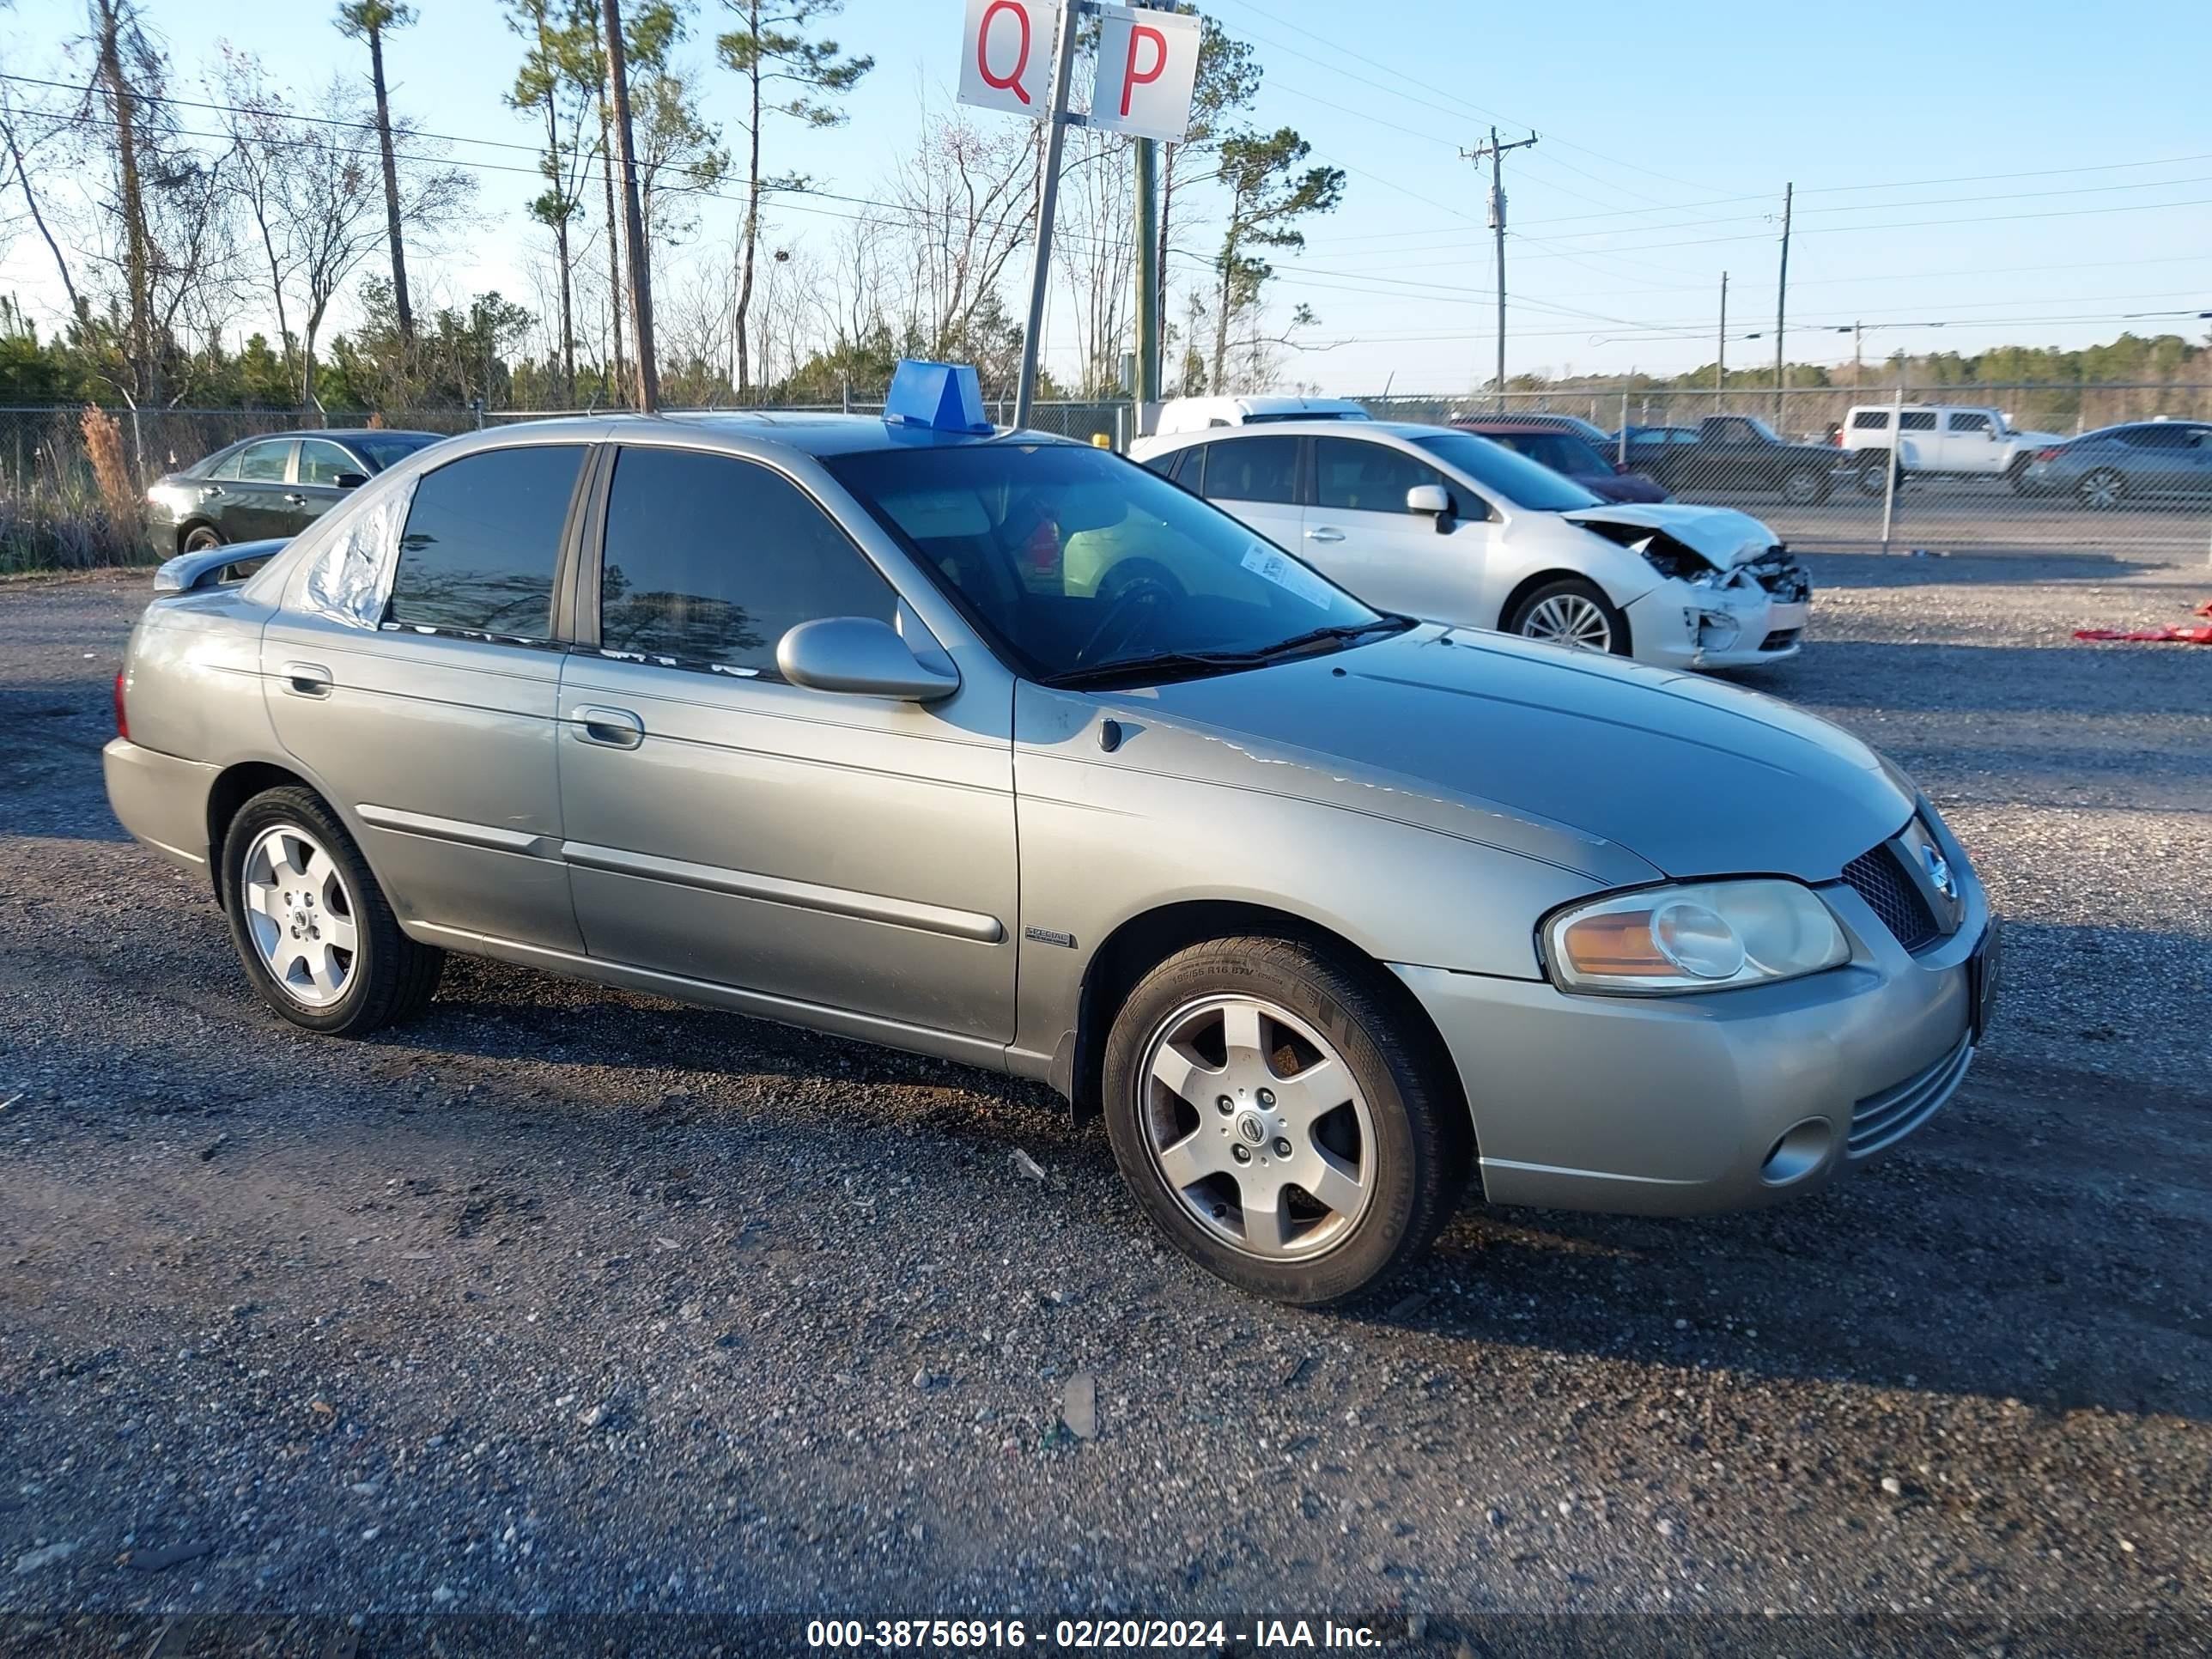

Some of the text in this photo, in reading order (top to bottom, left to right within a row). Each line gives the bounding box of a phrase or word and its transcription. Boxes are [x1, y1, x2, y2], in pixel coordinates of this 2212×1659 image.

[978, 0, 1030, 105] Q
[1121, 25, 1167, 117] P
[1207, 966, 1229, 976] R16
